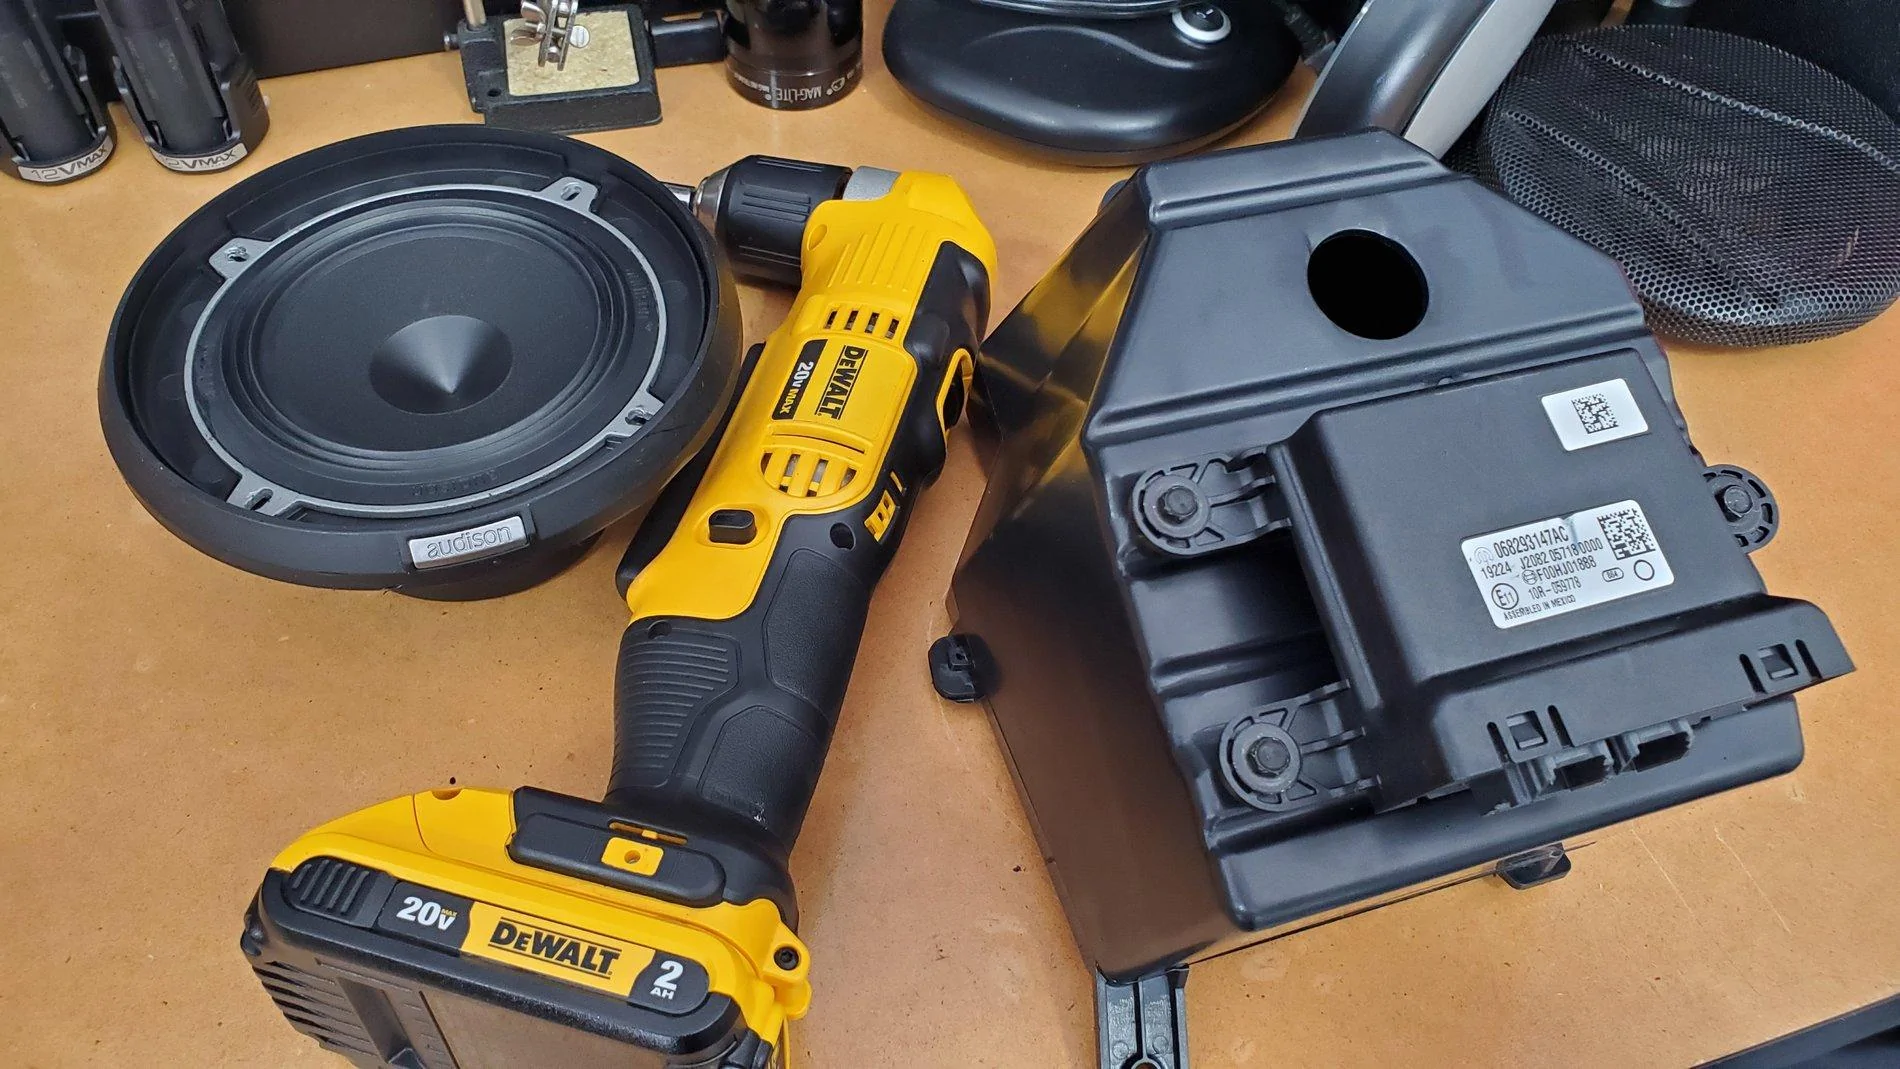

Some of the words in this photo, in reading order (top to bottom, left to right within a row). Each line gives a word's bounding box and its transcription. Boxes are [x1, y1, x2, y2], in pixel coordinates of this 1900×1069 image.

[426, 525, 512, 559] audison
[1493, 526, 1569, 559] 068293147AC
[1481, 561, 1512, 580] 19224
[1519, 552, 1551, 570] J2082
[1549, 544, 1579, 562] 05718
[1578, 537, 1604, 555] 0000
[1503, 604, 1542, 622] ASSEMBLED
[1543, 601, 1551, 611] IN
[1551, 594, 1576, 608] MEXICO
[653, 961, 685, 988] 2
[650, 987, 676, 1001] AH
